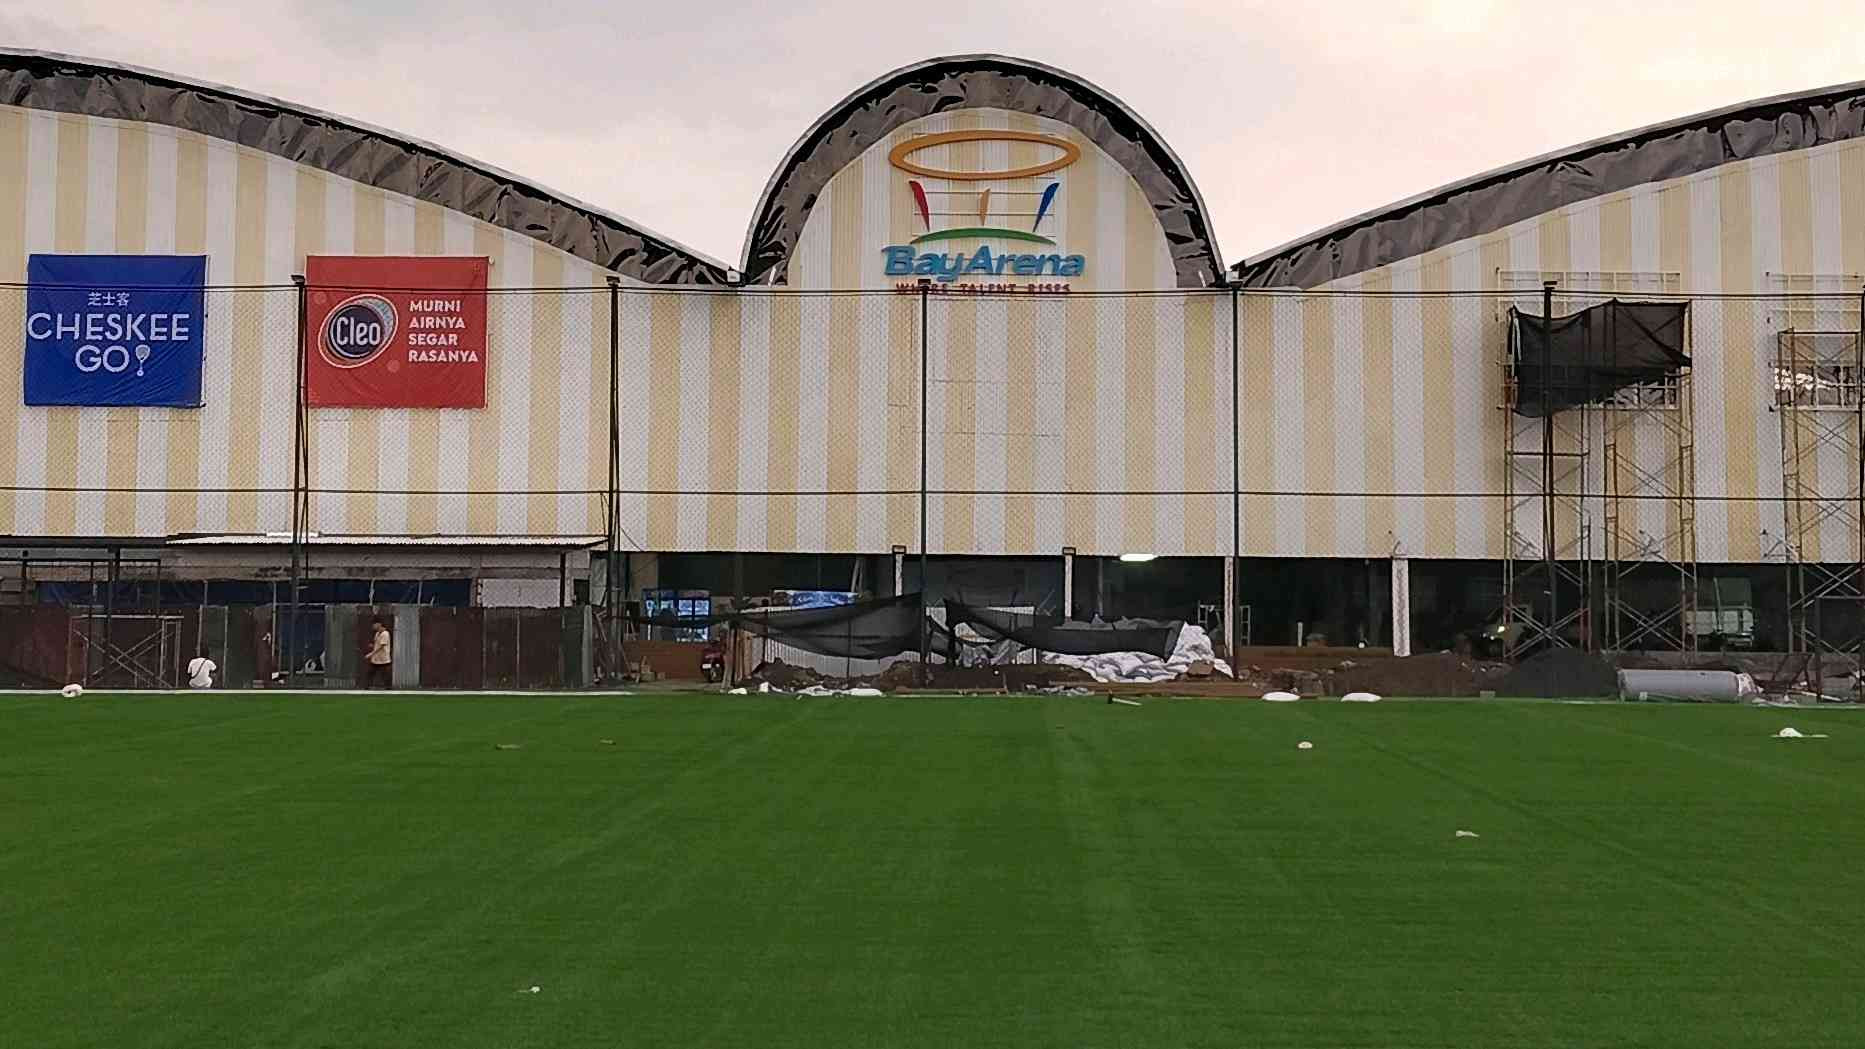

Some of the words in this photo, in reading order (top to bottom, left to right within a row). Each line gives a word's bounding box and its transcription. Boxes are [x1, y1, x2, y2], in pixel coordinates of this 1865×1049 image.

[881, 245, 1086, 282] BayArena
[896, 282, 949, 296] WHRE
[87, 291, 130, 306] 芝士客
[409, 299, 461, 313] MURNI
[27, 312, 190, 341] CHESKEE
[409, 316, 466, 330] AIRNYA
[336, 316, 382, 346] Cleo
[408, 333, 459, 347] SEGAR
[408, 350, 479, 364] RASANYA
